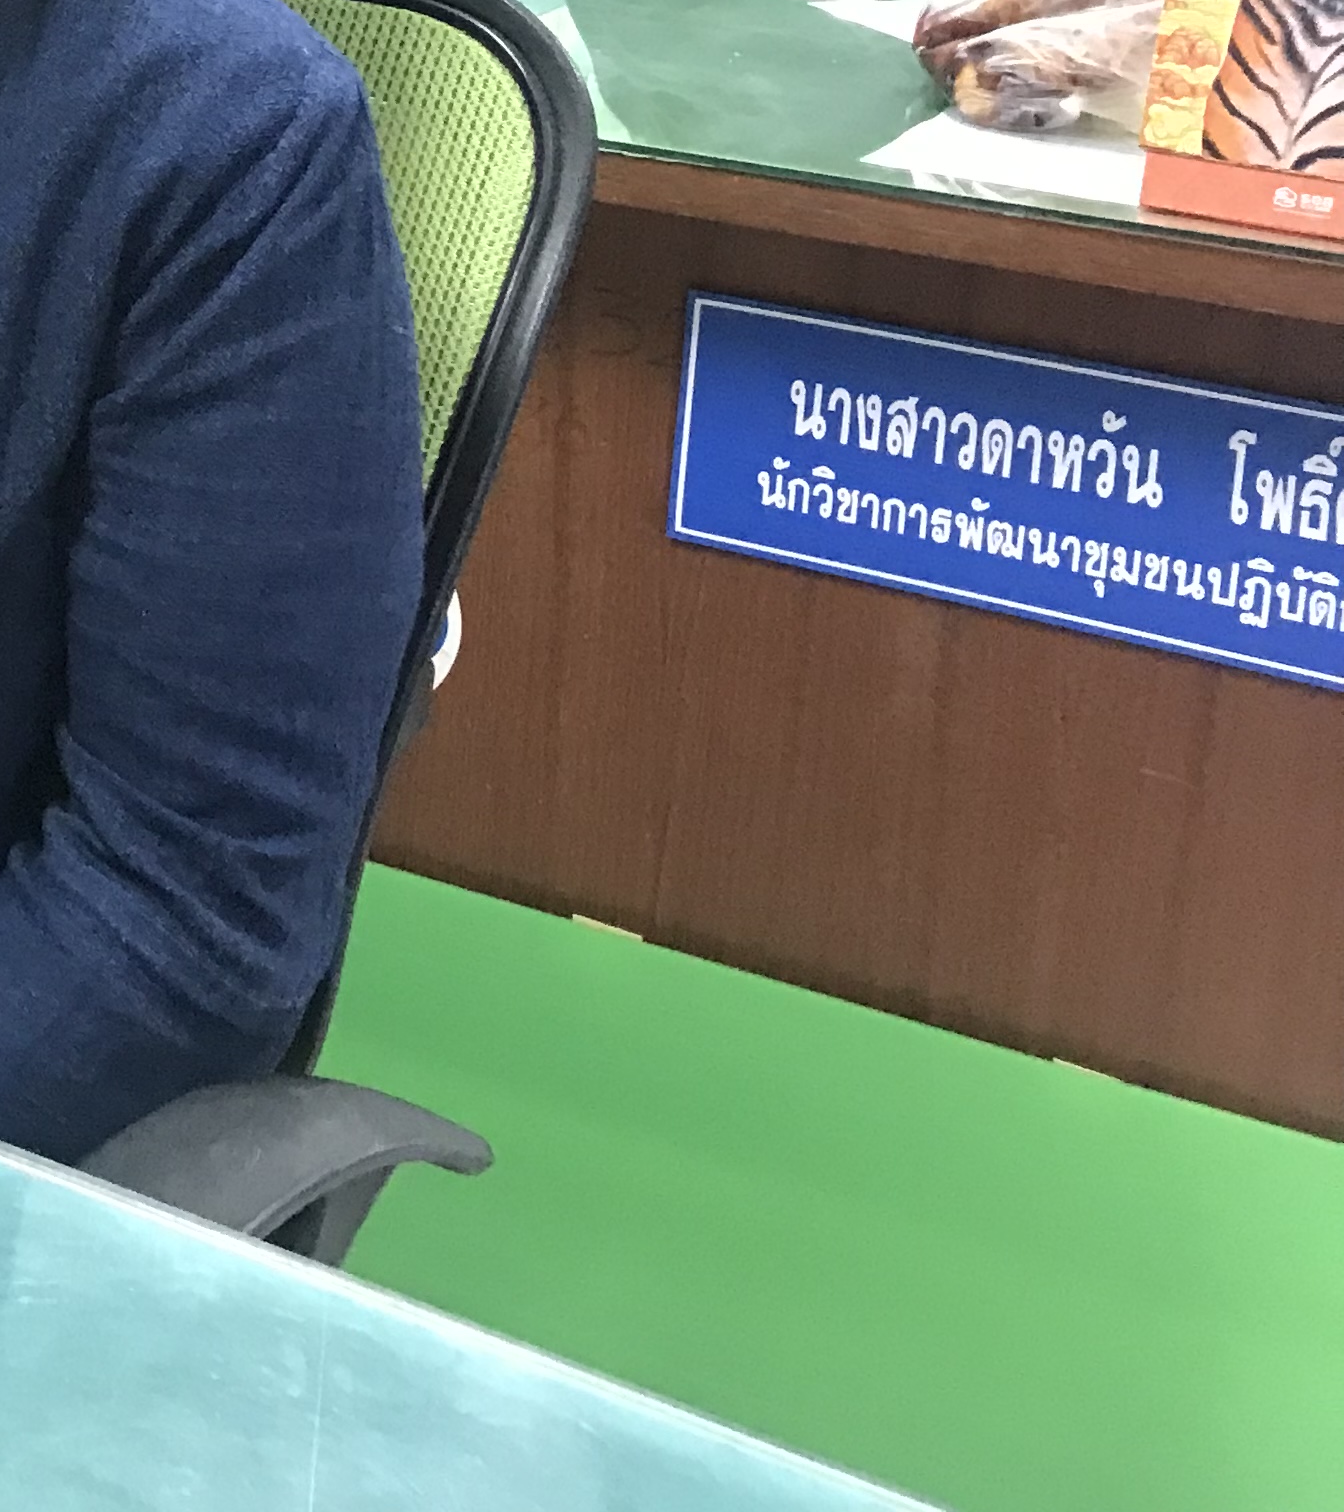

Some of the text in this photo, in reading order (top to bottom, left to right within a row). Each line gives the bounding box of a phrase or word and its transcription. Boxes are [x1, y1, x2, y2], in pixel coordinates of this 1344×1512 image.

[790, 379, 1164, 510] นางสาวดาหวัน
[756, 457, 1344, 633] นักวิชาการพัฒนาชุมชนปฏิบัติ
